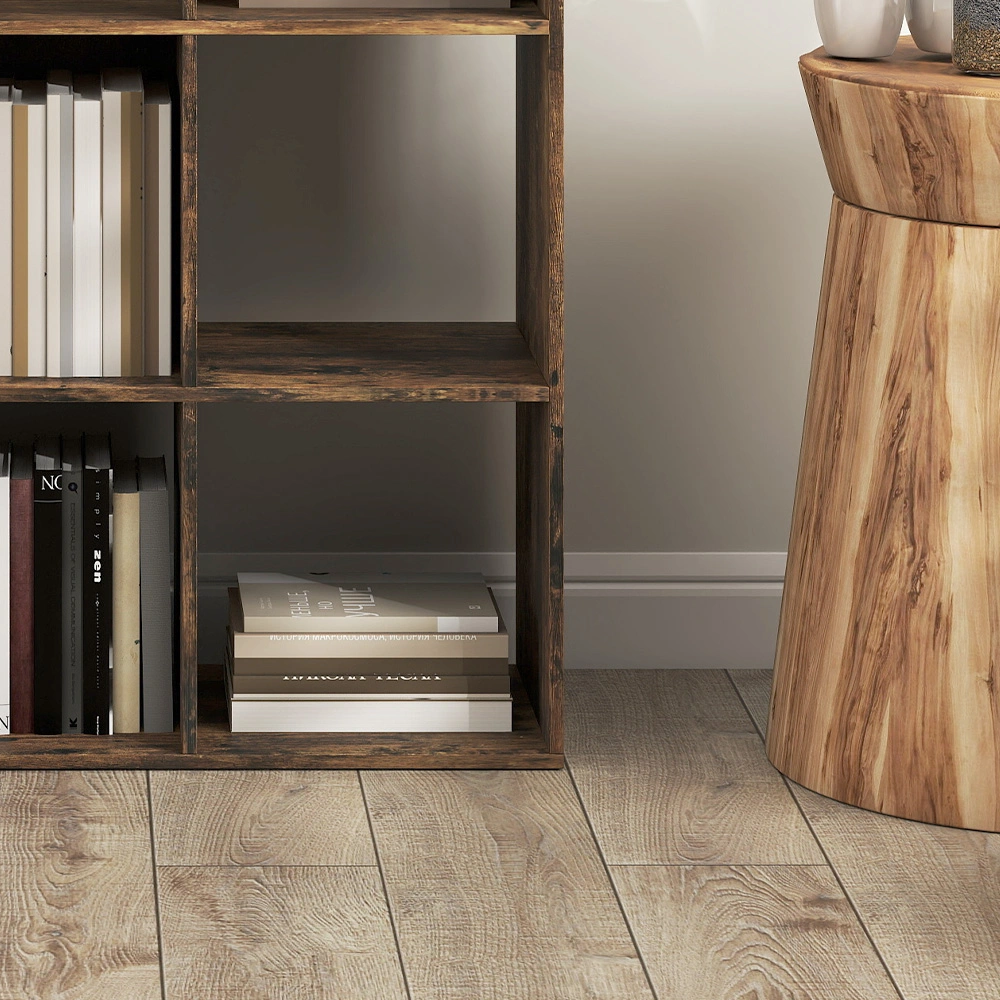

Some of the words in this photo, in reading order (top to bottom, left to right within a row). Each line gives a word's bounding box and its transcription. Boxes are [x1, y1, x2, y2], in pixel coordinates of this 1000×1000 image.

[93, 549, 102, 583] zen
[287, 590, 312, 618] ЕНЬШЕ,
[317, 601, 334, 610] НО
